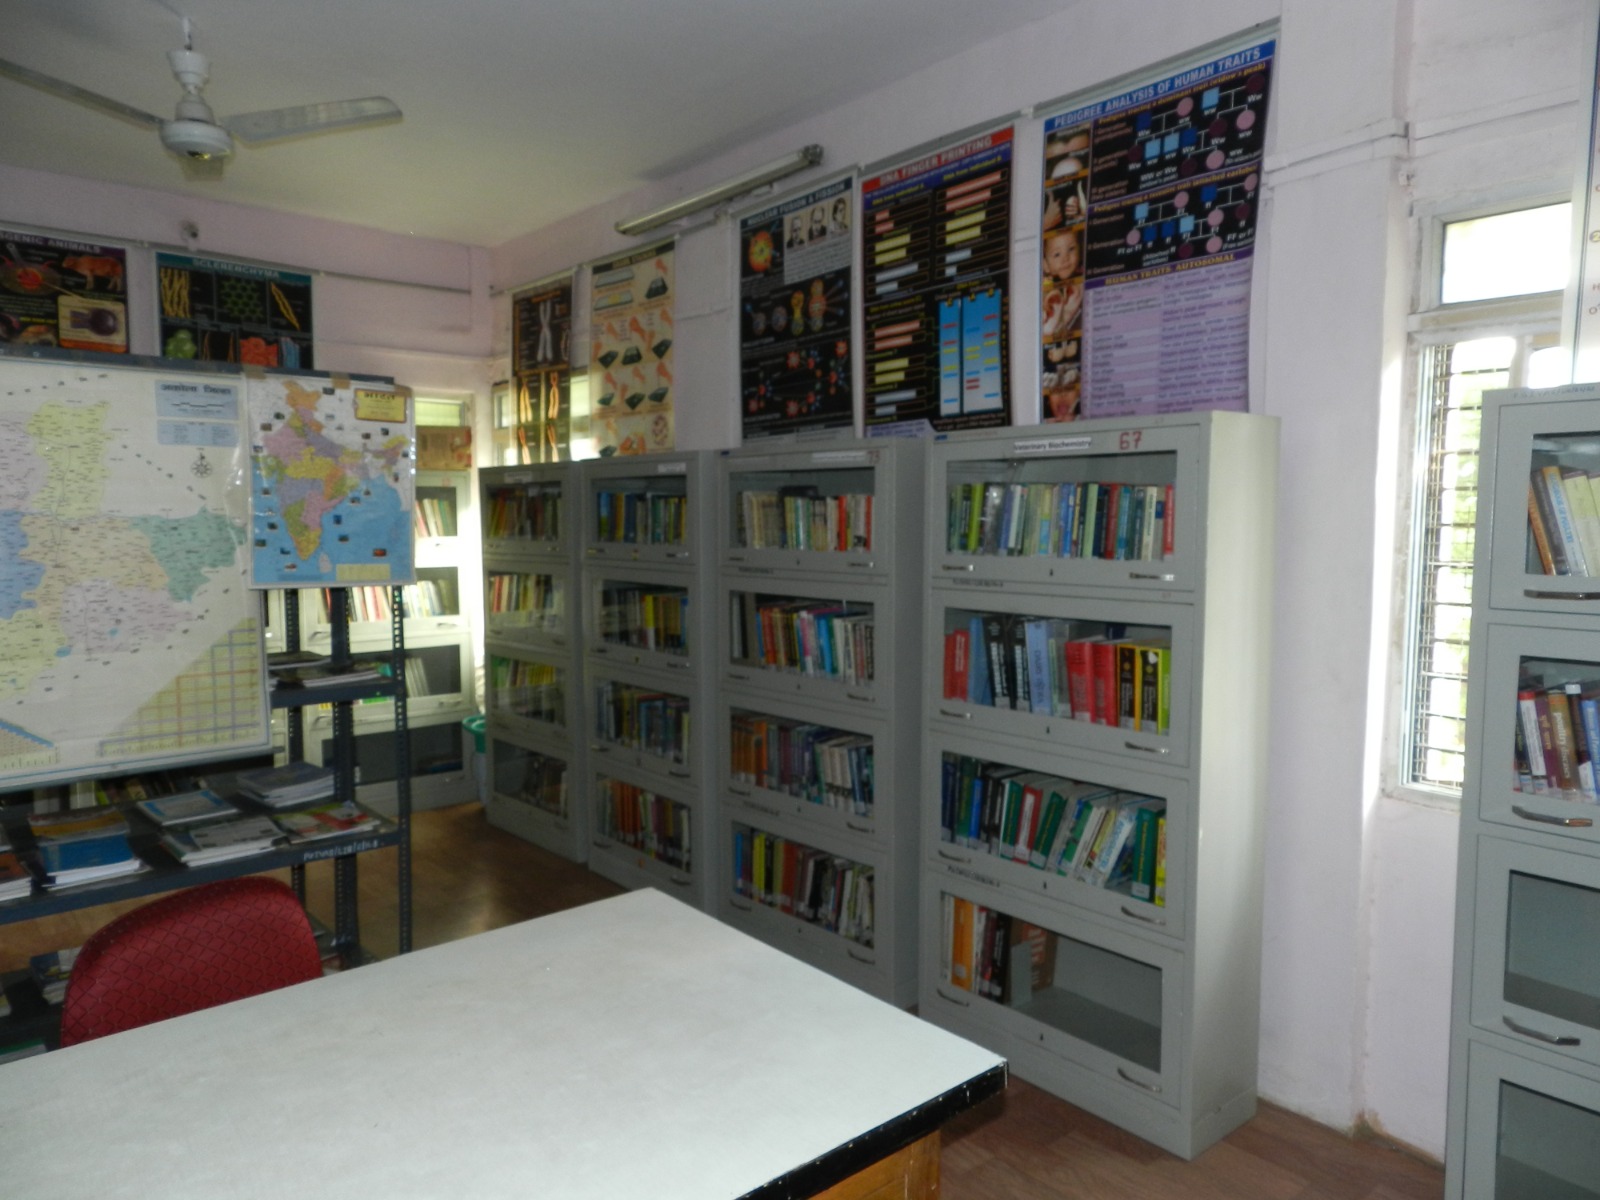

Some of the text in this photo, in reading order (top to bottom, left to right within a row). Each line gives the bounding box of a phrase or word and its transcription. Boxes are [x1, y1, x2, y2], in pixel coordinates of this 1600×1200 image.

[1054, 48, 1260, 128] PEDIGREE ANALYSIS OF HUMAN TRAITS
[902, 156, 938, 178] FINGER
[940, 136, 992, 164] PRINTING
[780, 198, 807, 214] FUSION
[816, 184, 845, 200] FISSION
[48, 240, 100, 254] ANIMALS
[192, 258, 280, 278] SCLERENCHYMA
[1105, 273, 1138, 285] HUMAN
[1175, 254, 1236, 272] AUTOSOMAL
[1048, 440, 1092, 448] Biochemistry
[1120, 431, 1142, 450] 67
[1554, 712, 1566, 746] poultry
